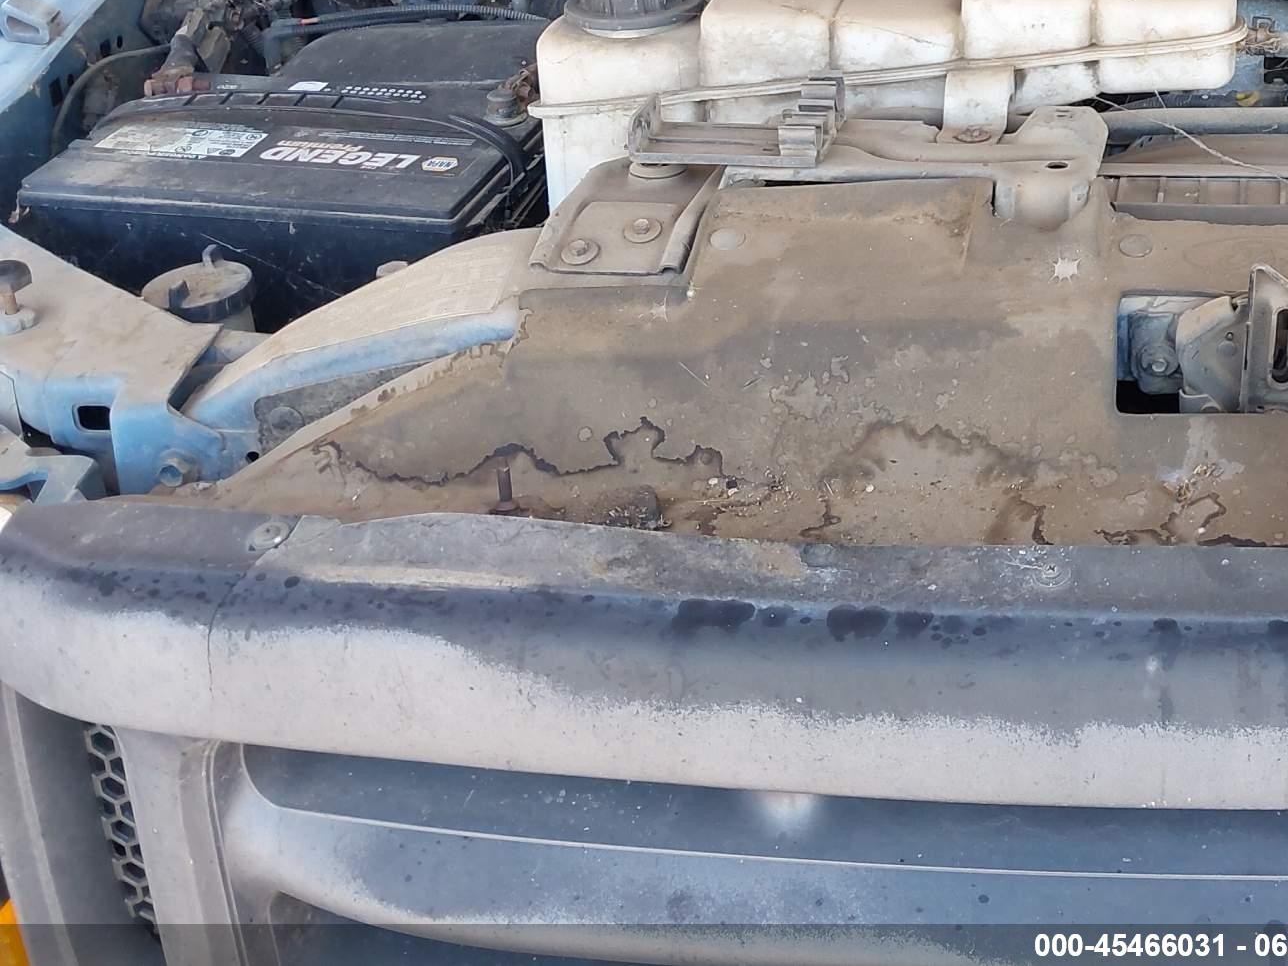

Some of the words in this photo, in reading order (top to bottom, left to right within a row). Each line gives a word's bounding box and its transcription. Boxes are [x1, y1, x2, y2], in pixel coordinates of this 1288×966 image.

[276, 139, 364, 152] Premium
[259, 146, 421, 169] LEGEND
[426, 159, 455, 168] NAPA
